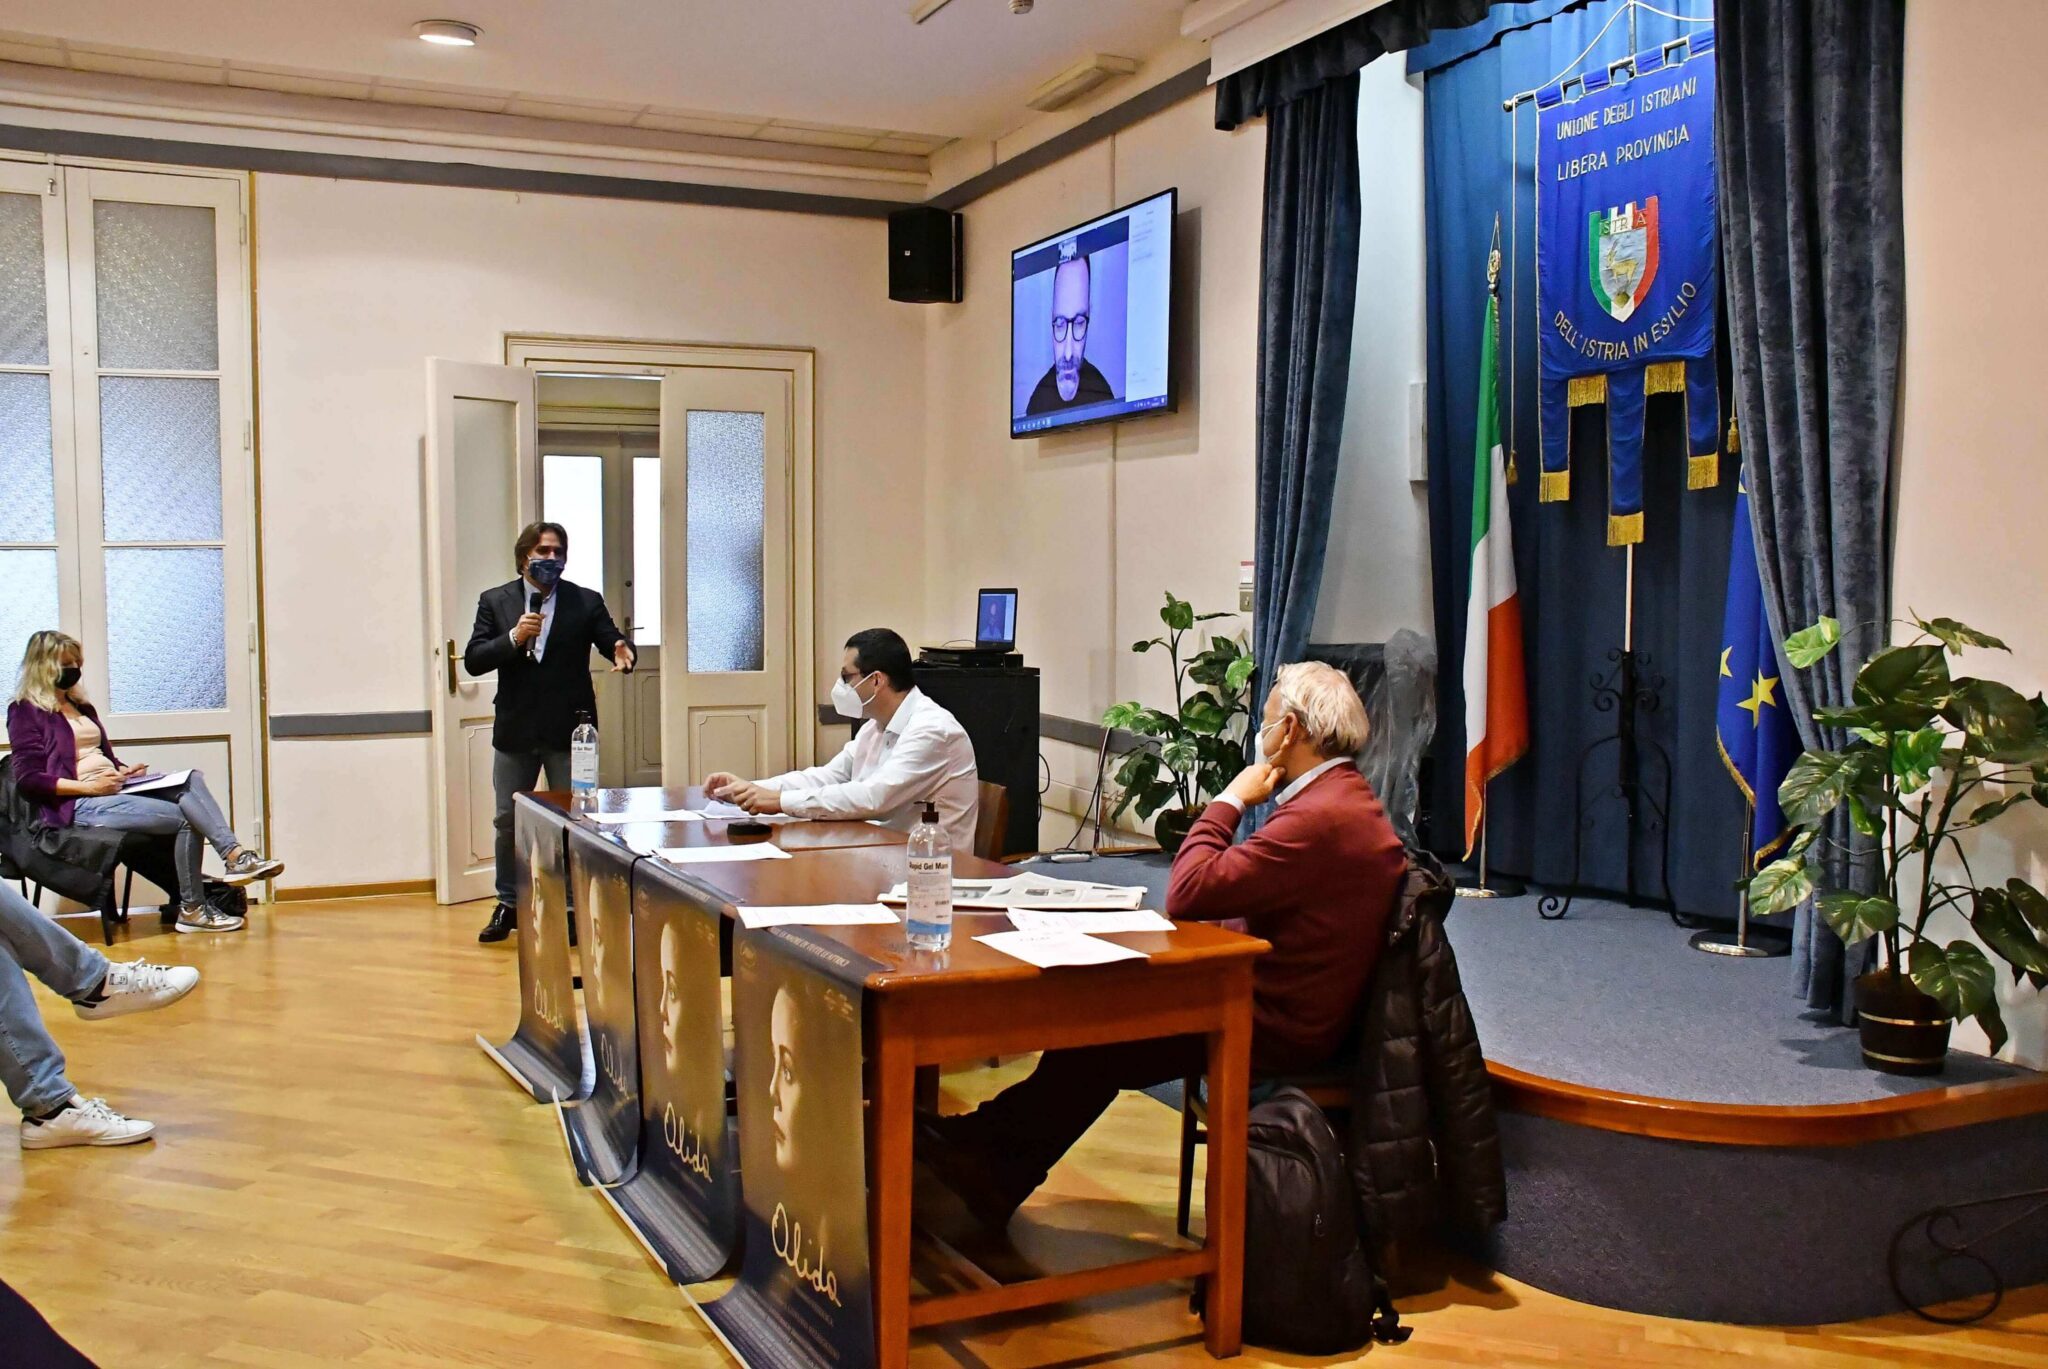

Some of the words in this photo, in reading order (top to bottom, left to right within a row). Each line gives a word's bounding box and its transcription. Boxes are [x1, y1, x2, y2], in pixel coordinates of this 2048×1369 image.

[1556, 110, 1599, 141] UNIONE
[1603, 101, 1635, 127] DEGLI
[1641, 76, 1697, 114] ISTRIANI
[1557, 151, 1608, 181] LIBERA
[1616, 124, 1690, 165] PROVINCIA
[1633, 332, 1649, 354] IN
[1651, 282, 1697, 343] ESILIO
[923, 862, 934, 870] Gel
